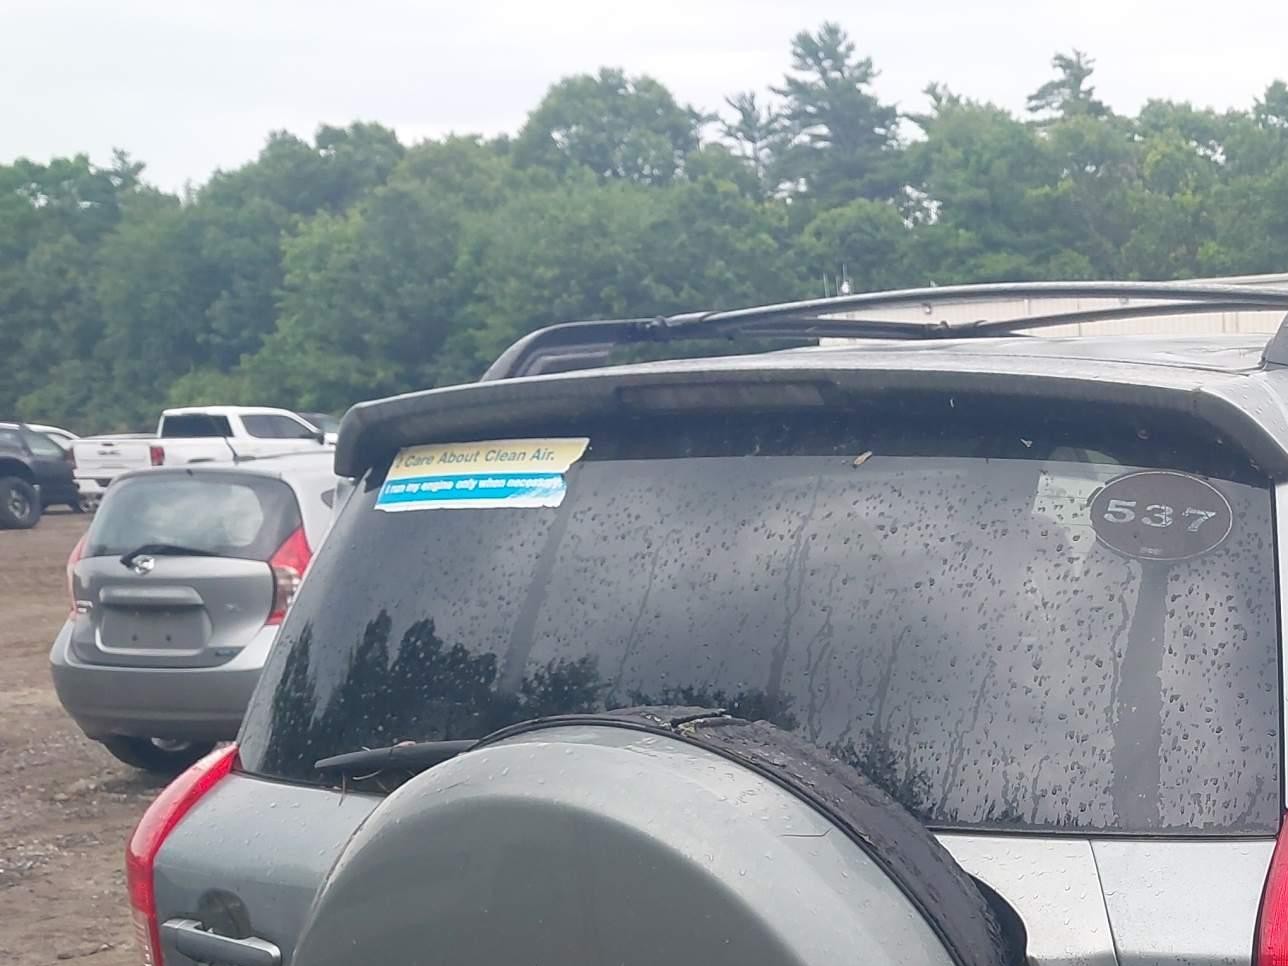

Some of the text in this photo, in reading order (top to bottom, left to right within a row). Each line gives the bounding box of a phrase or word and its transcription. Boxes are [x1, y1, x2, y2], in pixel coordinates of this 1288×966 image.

[404, 454, 435, 468] Care
[437, 449, 481, 464] About
[485, 448, 527, 462] Clean
[530, 446, 555, 461] Air.
[1103, 499, 1217, 533] 537
